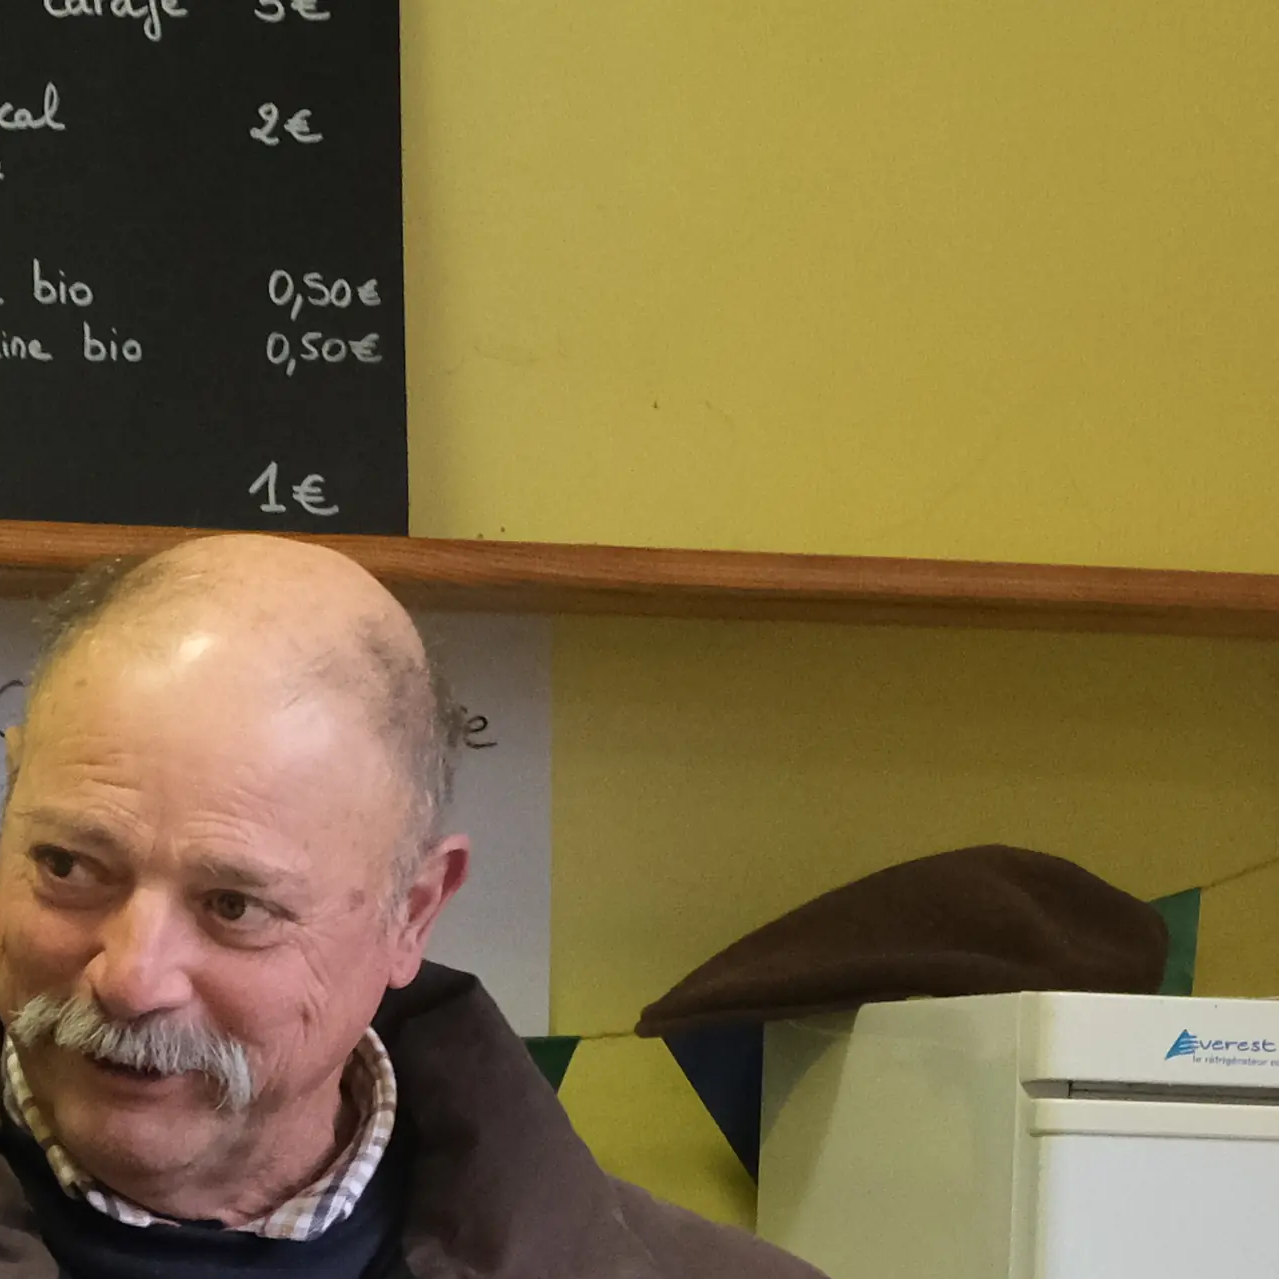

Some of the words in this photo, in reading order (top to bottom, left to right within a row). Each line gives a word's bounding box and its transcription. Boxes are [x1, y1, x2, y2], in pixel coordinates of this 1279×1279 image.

[249, 102, 323, 145] 2€
[33, 258, 93, 306] bio
[268, 270, 381, 320] 0,50€
[83, 322, 142, 362] bio
[266, 331, 382, 376] 0,50€
[248, 461, 339, 516] 1€
[1165, 1029, 1277, 1060] Everest
